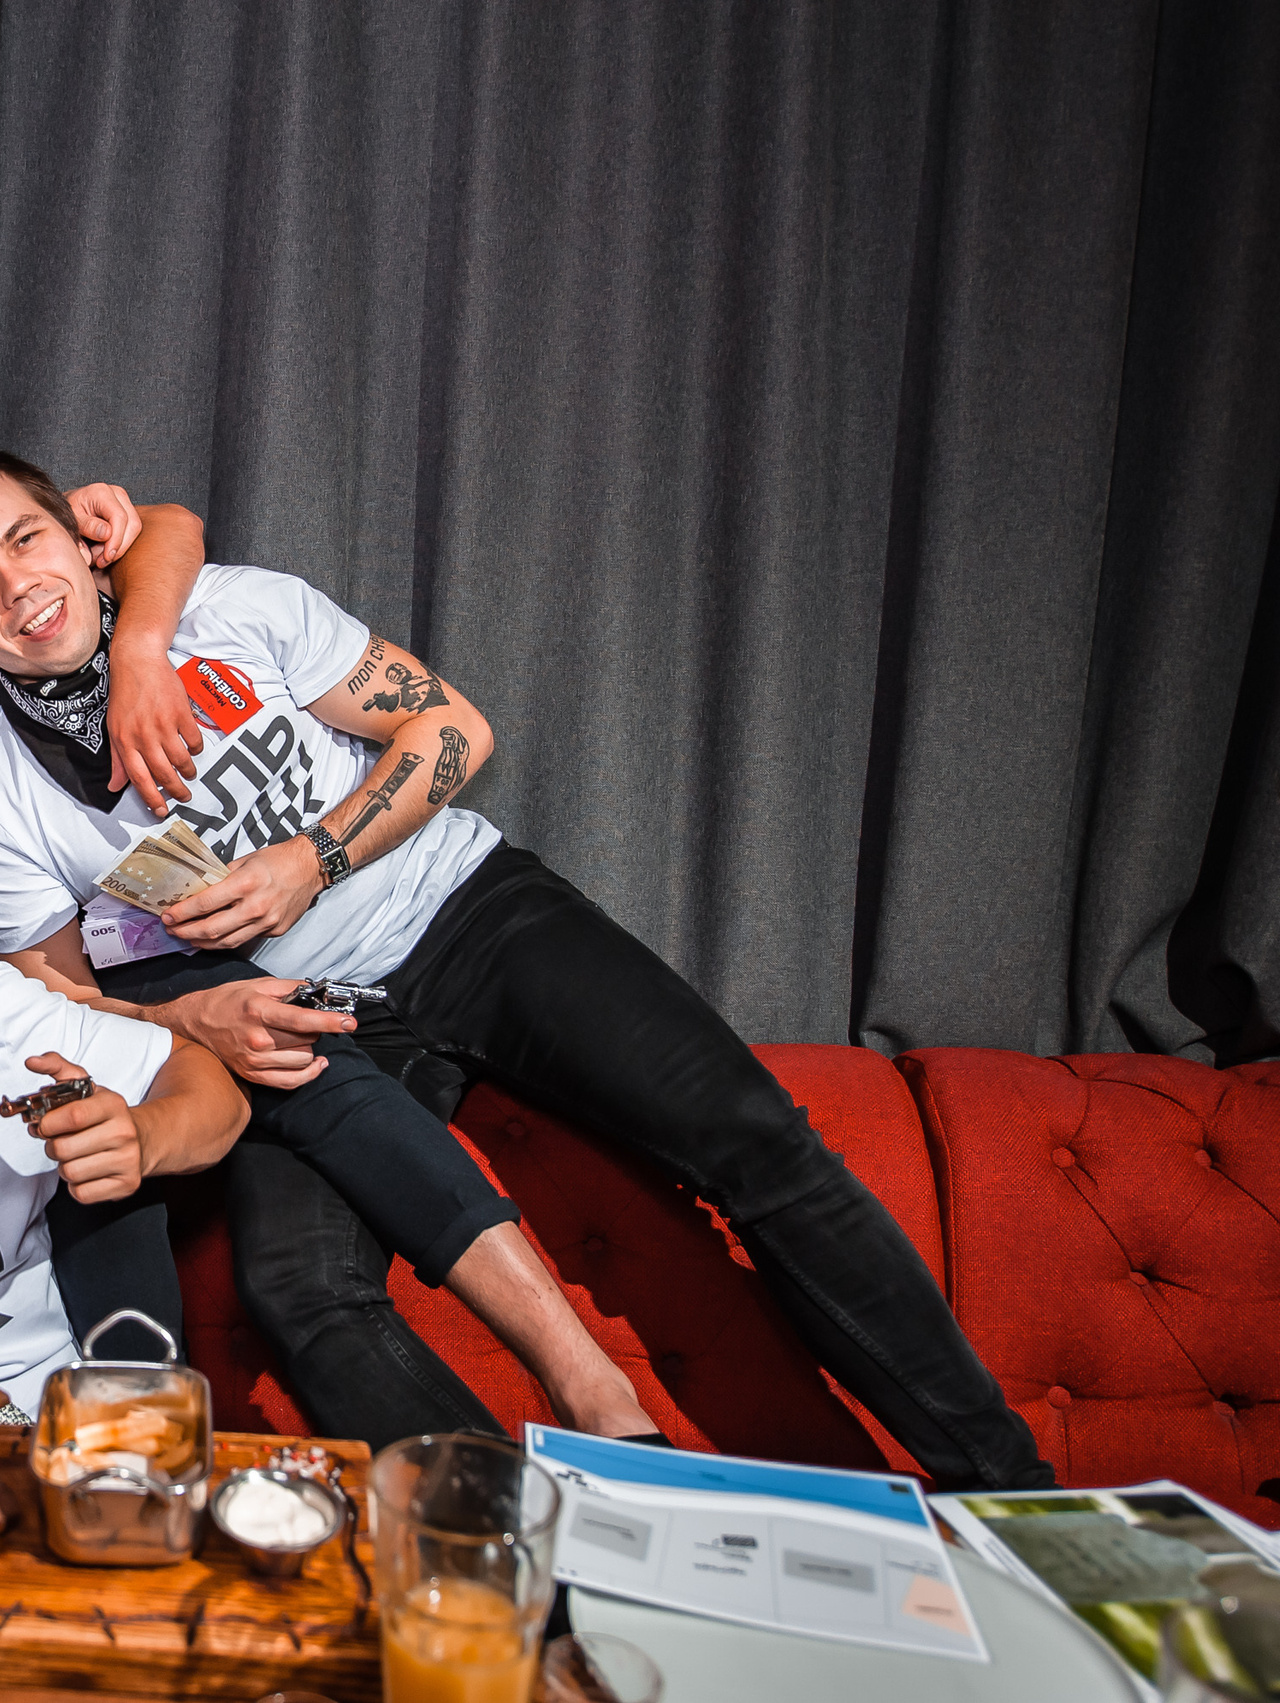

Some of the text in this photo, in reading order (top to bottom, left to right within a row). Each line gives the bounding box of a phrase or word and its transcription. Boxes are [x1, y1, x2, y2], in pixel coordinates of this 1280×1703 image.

[201, 680, 227, 707] Мистер
[164, 714, 295, 848] АЛЬ
[101, 876, 126, 892] 200
[91, 925, 116, 937] 500
